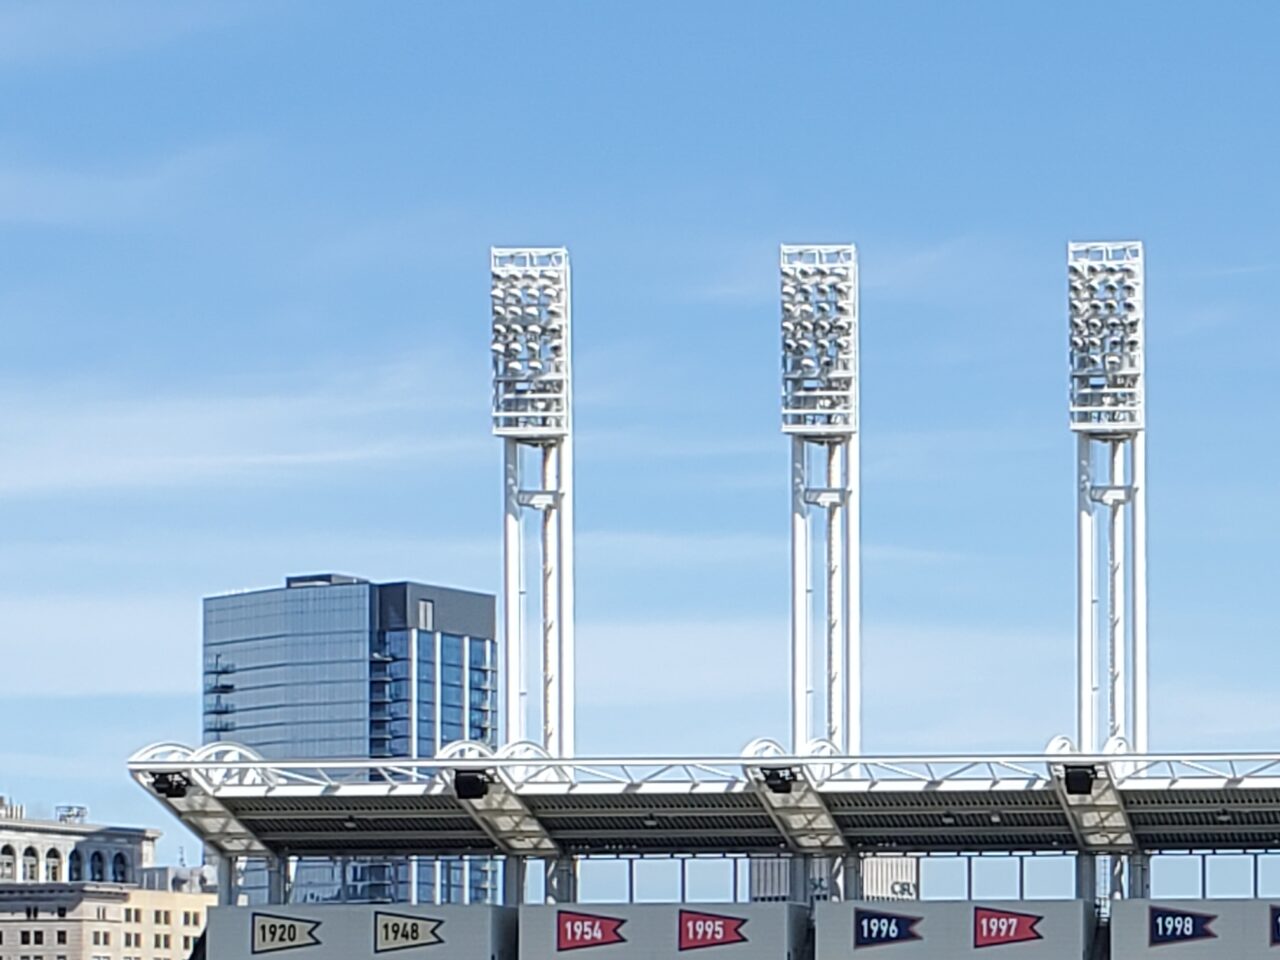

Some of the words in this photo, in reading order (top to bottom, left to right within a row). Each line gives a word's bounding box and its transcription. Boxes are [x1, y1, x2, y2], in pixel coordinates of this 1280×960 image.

[259, 924, 297, 943] 1920
[382, 922, 420, 941] 1948
[565, 920, 603, 940] 1954
[686, 920, 724, 940] 1995
[861, 918, 899, 938] 1996
[980, 918, 1018, 937] 1997
[1156, 916, 1194, 936] 1998
